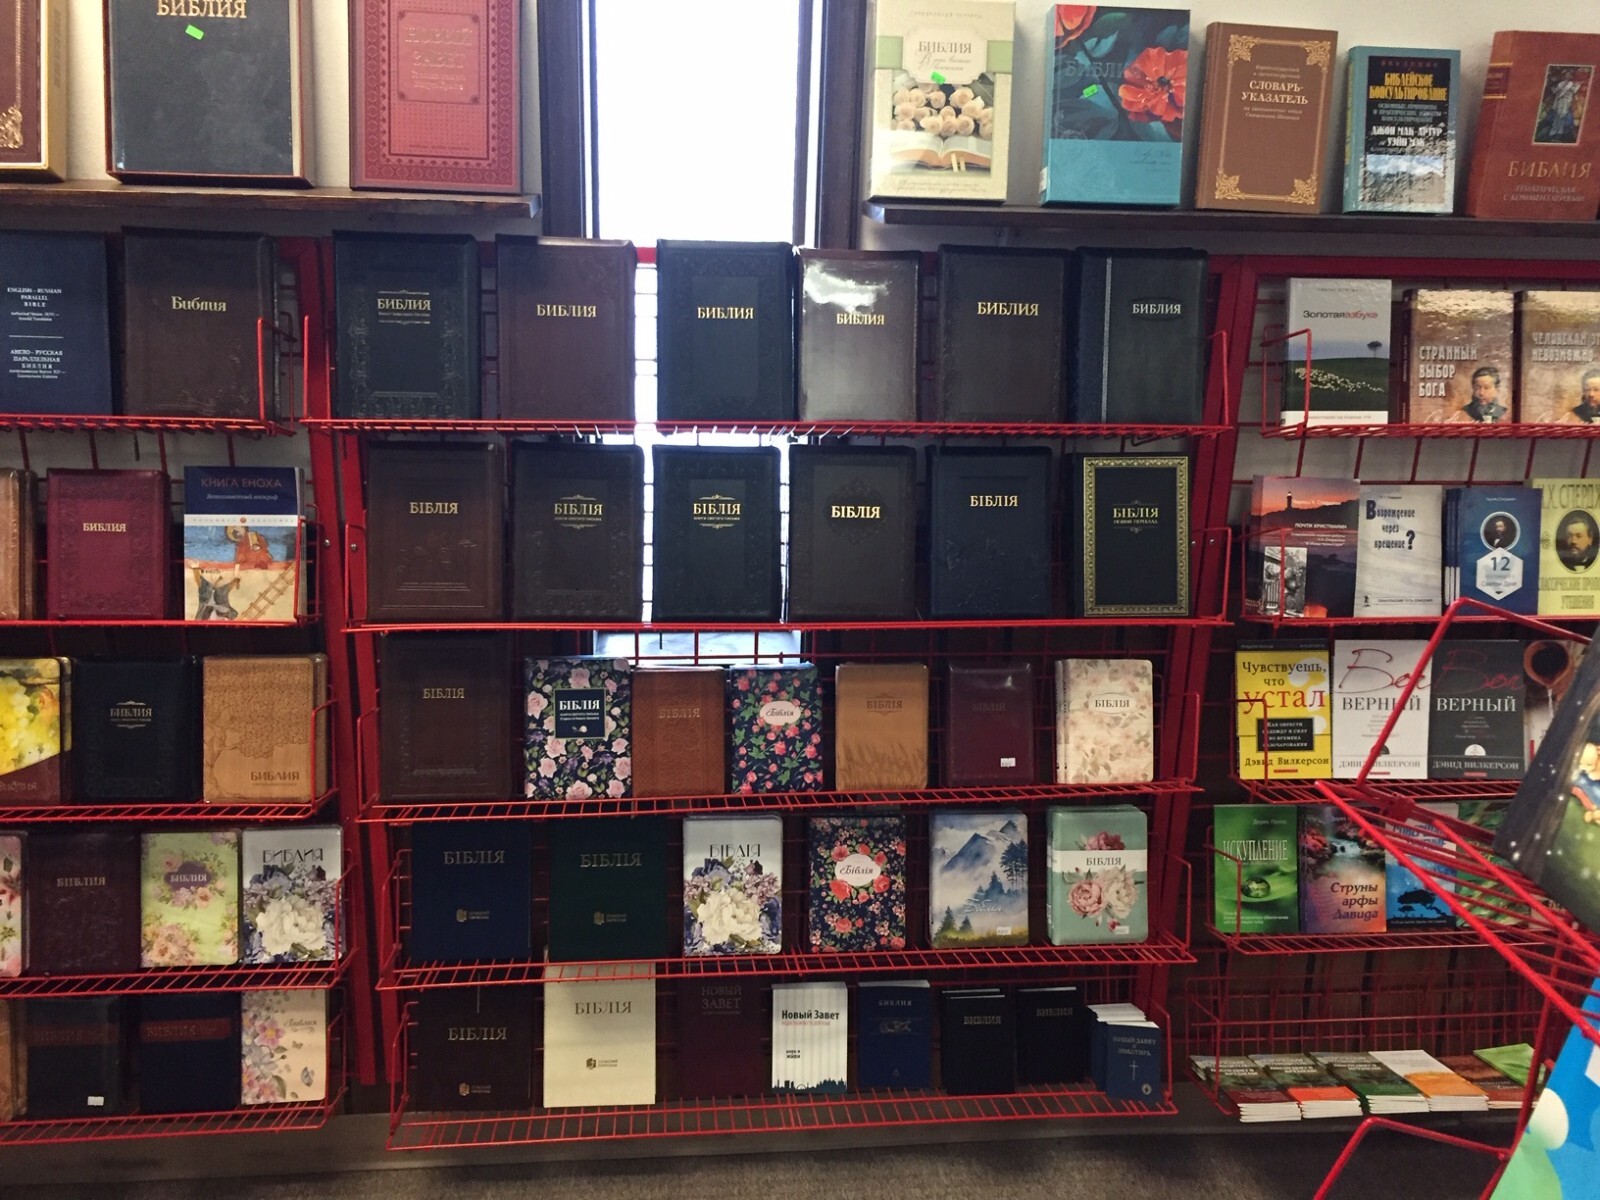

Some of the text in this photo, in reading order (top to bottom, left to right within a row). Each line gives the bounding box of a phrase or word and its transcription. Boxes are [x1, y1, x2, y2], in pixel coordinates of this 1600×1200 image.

[157, 0, 247, 19] БИБЛИЯ
[919, 41, 972, 54] БИБЛИЯ
[1241, 92, 1309, 105] УКАЗАТЕЛЬ
[1508, 161, 1592, 178] БИБЛИЯ
[171, 295, 227, 312] Библия
[377, 298, 432, 310] БИБЛИЯ
[977, 301, 1039, 316] БИБЛИЯ
[1132, 303, 1182, 314] БИБЛИЯ
[536, 304, 597, 318] БИБЛИЯ
[697, 306, 754, 319] БИБЛИЯ
[836, 312, 885, 325] БИБЛИЯ
[1419, 364, 1456, 379] ВЫБОР
[1418, 382, 1446, 397] БОГА
[201, 478, 282, 488] КНИГА ЕНОХА
[970, 495, 1018, 507] БІБЛІЯ
[409, 502, 459, 514] БІБЛІЯ
[554, 503, 603, 515] БІБЛІЯ
[693, 503, 741, 515] БІБЛІЯ
[831, 505, 881, 519] БІБЛІЯ
[1113, 507, 1159, 518] БІБЛІЯ
[1366, 500, 1415, 520] Возрождение
[83, 523, 127, 532] БИБЛИЯ
[1382, 524, 1399, 534] через
[1490, 556, 1510, 571] 12
[1242, 661, 1326, 676] Чувствуешь,
[1264, 678, 1286, 687] что
[422, 687, 465, 699] БІБЛІЯ
[559, 700, 600, 711] БІБЛІЯ
[866, 700, 903, 709] БІБЛІЯ
[1095, 699, 1130, 708] БІБЛІЯ
[1243, 690, 1326, 714] устал
[1436, 696, 1517, 712] ВЕРНЫЙ
[110, 708, 152, 717] БИБЛИЯ
[659, 708, 701, 719] БІБЛІЯ
[1278, 756, 1330, 765] Вилкерсон
[1432, 761, 1520, 771] ДЭВИД ВИЛКЕРСОН
[250, 771, 300, 781] БИБЛИЯ
[263, 848, 324, 864] БИБЛИЯ
[710, 844, 761, 858] БІБЛІЯ
[1222, 839, 1289, 861] ИСКУПЛЕНИЕ
[443, 850, 505, 865] БІБЛІЯ
[580, 852, 642, 868] БІБЛІЯ
[1086, 857, 1122, 866] БІБЛІЯ
[57, 876, 106, 887] БИБЛИЯ
[170, 873, 207, 883] БИБЛИЯ
[1331, 882, 1378, 895] Струны
[1342, 896, 1378, 908] арфы
[1332, 909, 1379, 922] Давида
[701, 984, 742, 995] НОВЫЙ
[575, 1001, 632, 1015] БІБЛІЯ
[701, 998, 742, 1009] ЗАВЕТ
[782, 1010, 840, 1020] Новый Завет
[1036, 1008, 1074, 1017] БИБЛИЯ
[963, 1016, 1002, 1025] БИБЛИЯ
[448, 1026, 508, 1041] БІБЛІЯ
